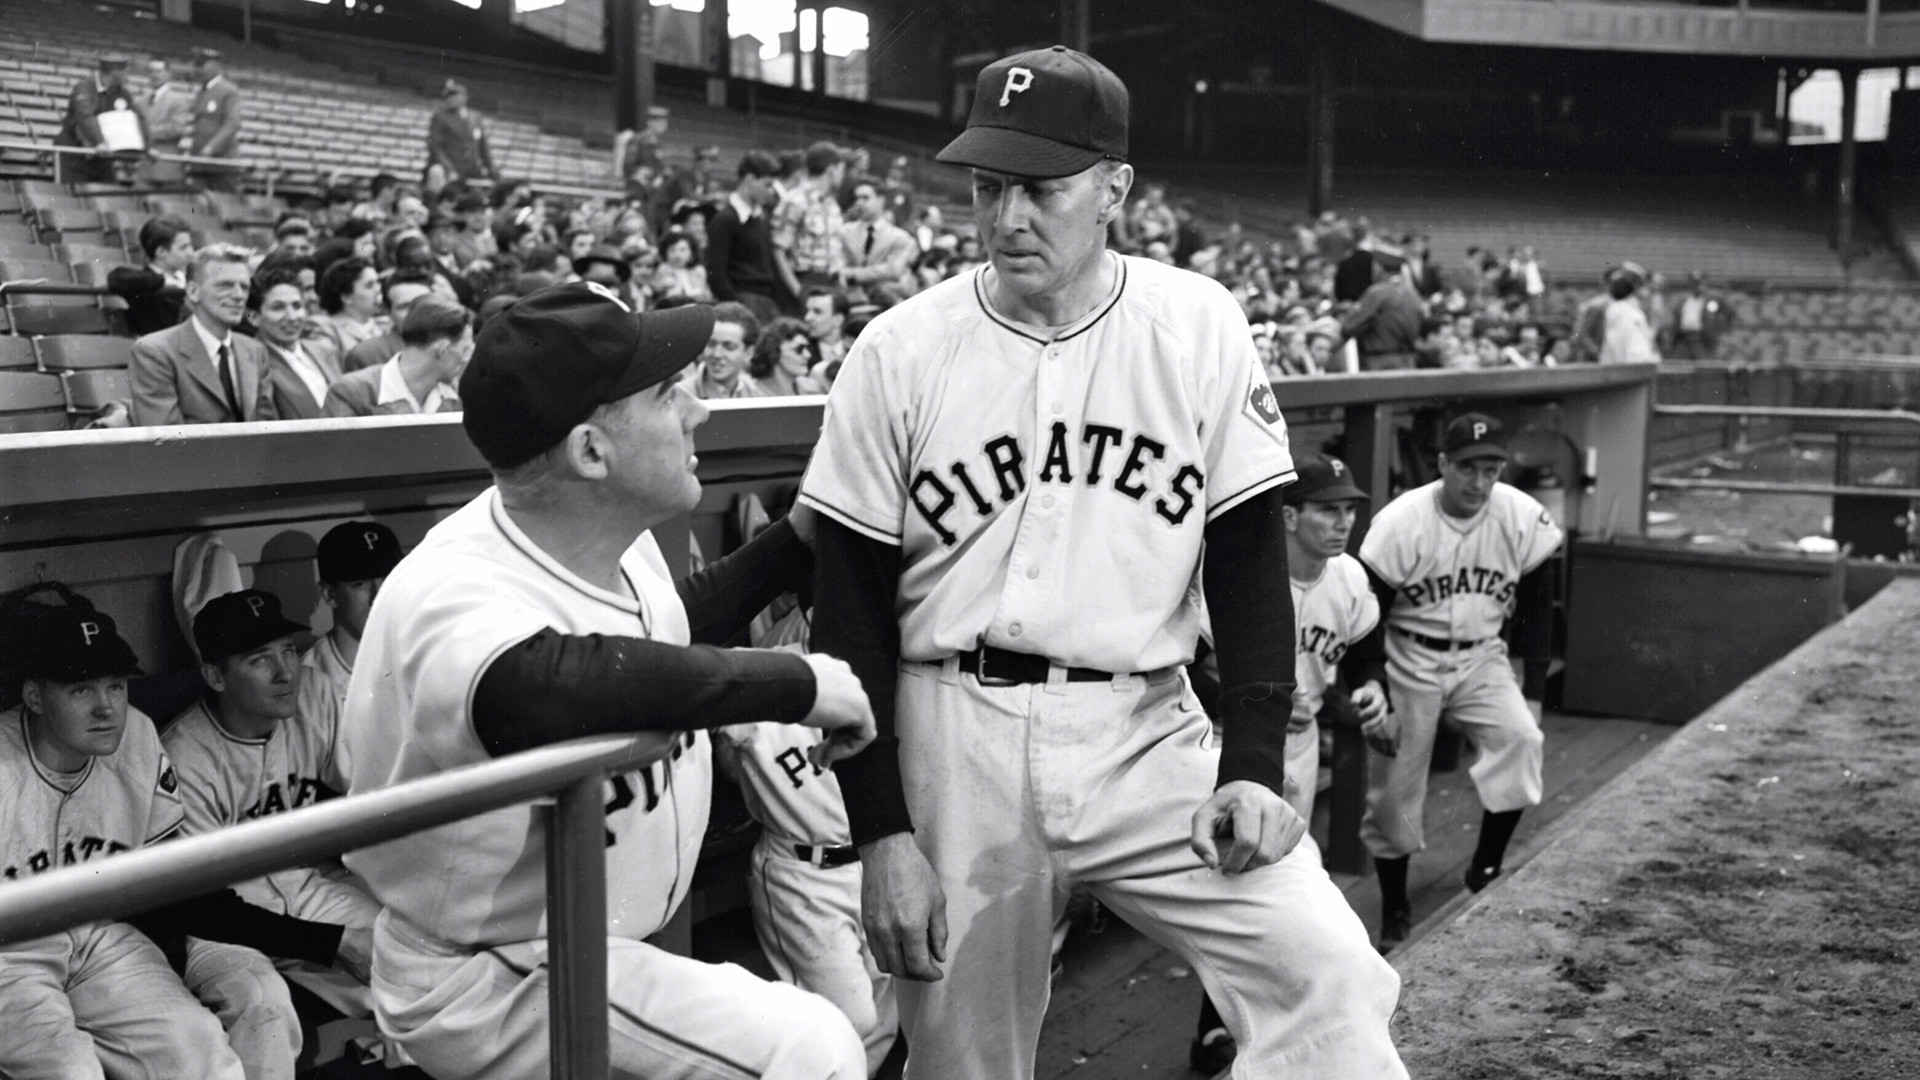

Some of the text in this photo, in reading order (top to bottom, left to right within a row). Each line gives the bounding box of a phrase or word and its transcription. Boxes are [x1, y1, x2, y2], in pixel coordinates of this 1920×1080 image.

[999, 67, 1034, 107] P
[1473, 422, 1487, 440] P
[1331, 459, 1344, 477] P
[910, 422, 1204, 546] PIRATES
[364, 532, 378, 550] P
[1402, 567, 1518, 606] PIRATES
[247, 597, 264, 617] P
[81, 622, 100, 645] P
